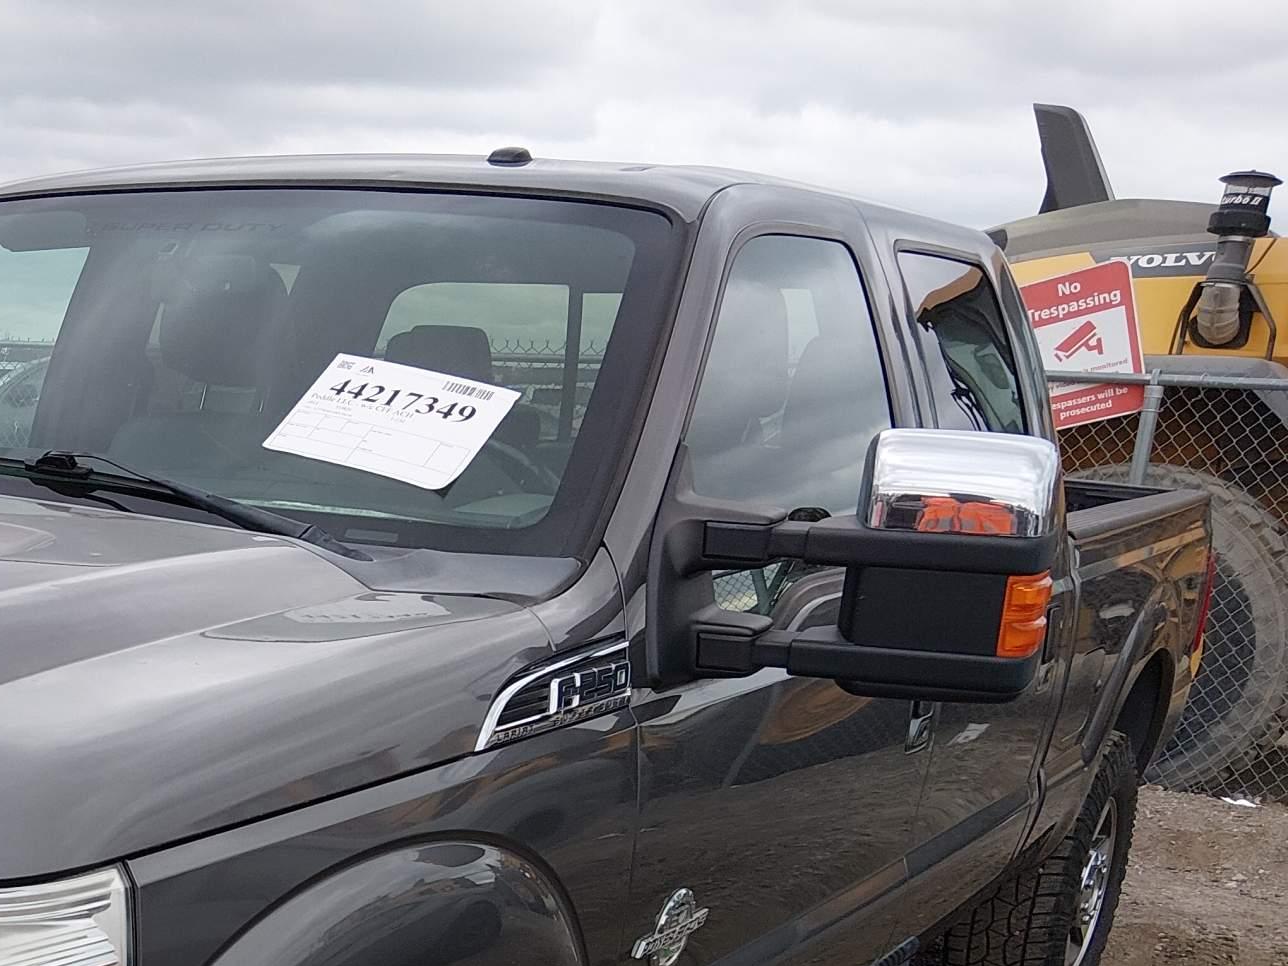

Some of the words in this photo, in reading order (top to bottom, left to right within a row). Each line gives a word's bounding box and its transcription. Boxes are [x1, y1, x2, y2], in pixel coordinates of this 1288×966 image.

[1110, 252, 1216, 268] VOLV
[1057, 282, 1081, 296] No
[1027, 290, 1121, 321] Trespassing
[329, 379, 477, 423] 44217349
[1097, 387, 1114, 399] will
[1116, 385, 1129, 395] be
[1060, 400, 1113, 420] prosecuted
